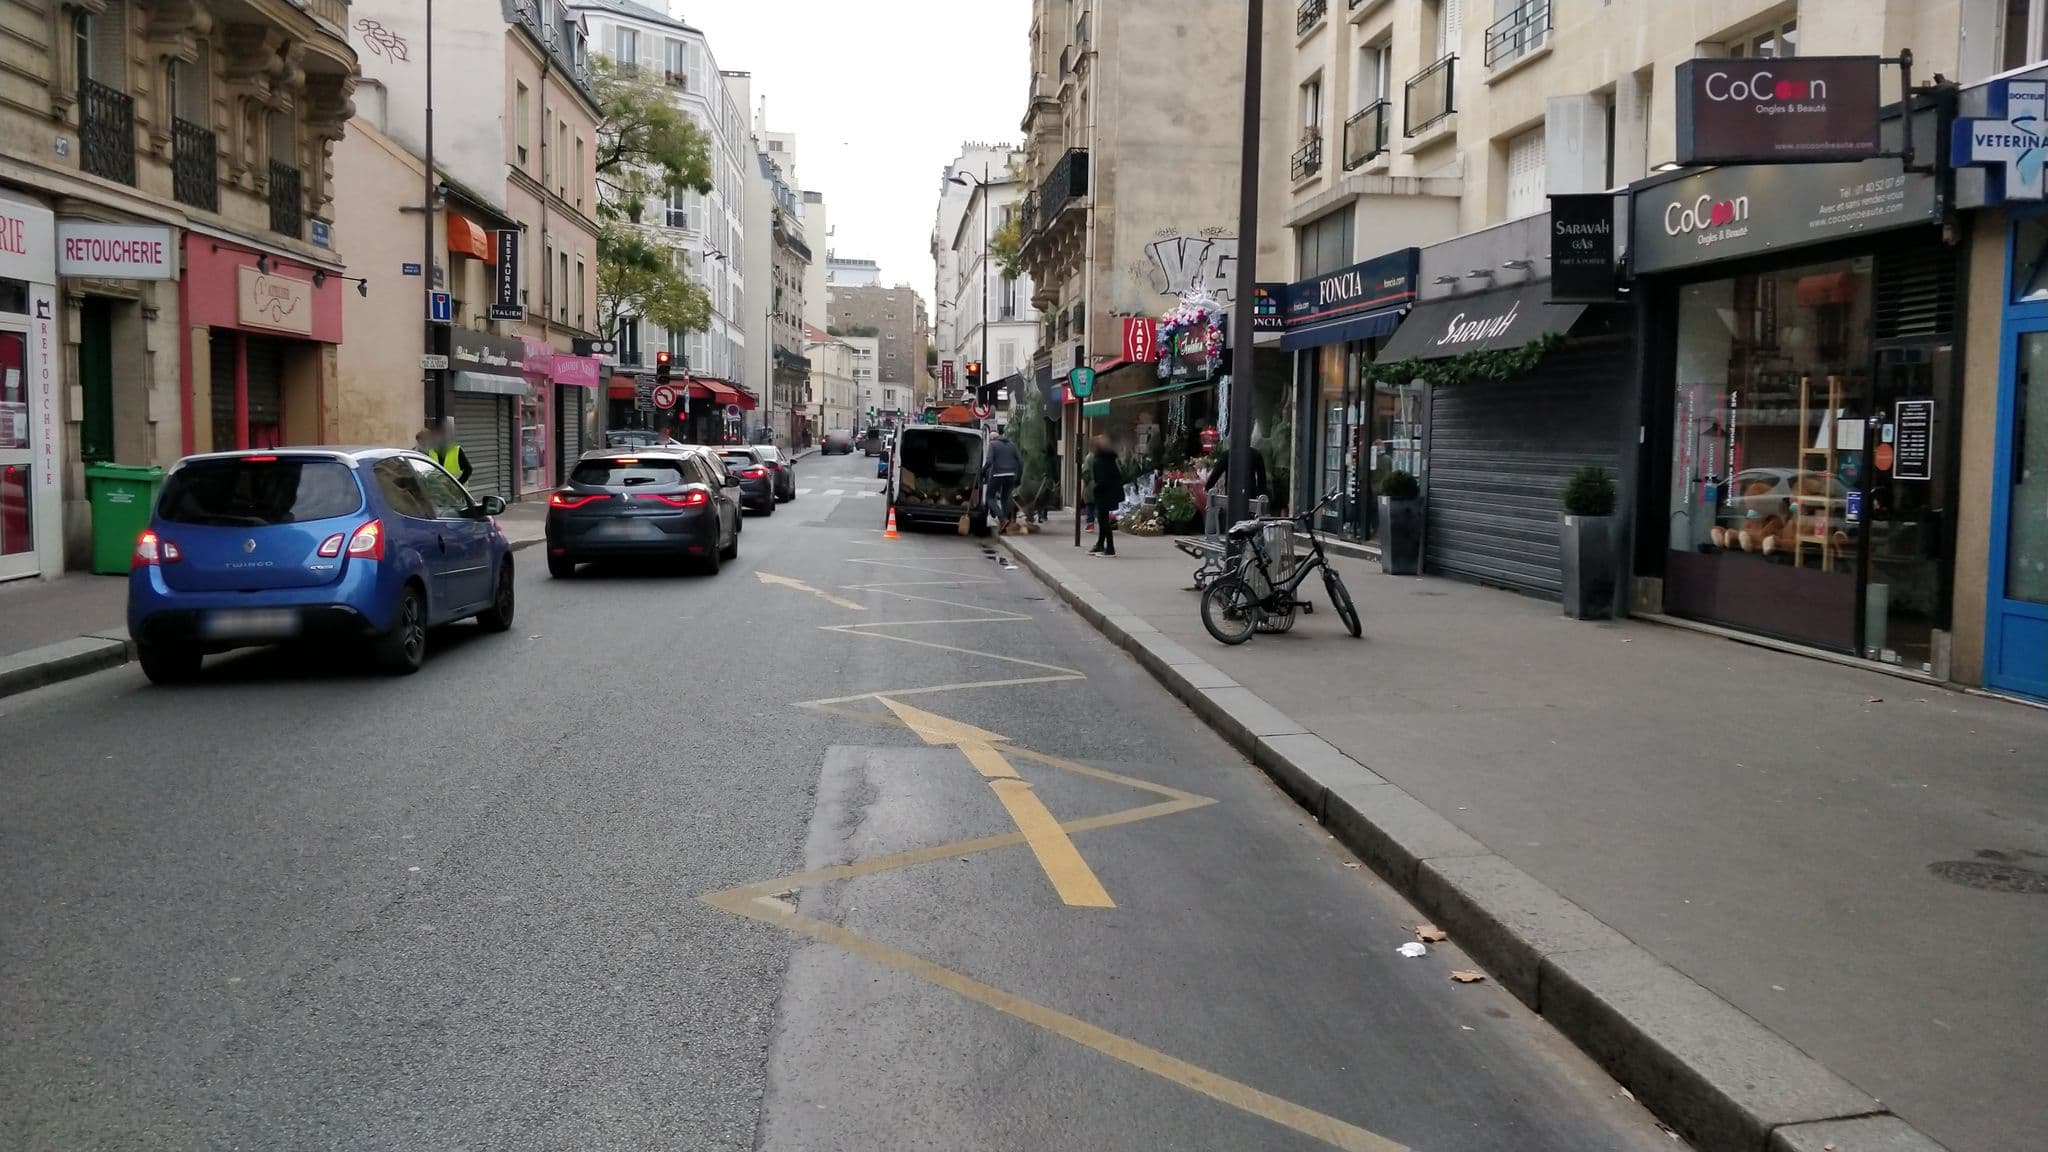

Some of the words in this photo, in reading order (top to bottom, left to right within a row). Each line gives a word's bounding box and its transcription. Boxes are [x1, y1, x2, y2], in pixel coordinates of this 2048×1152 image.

[2009, 92, 2045, 100] DOCTEUR
[1756, 104, 1786, 115] Ongles
[1788, 104, 1794, 113] &
[1797, 103, 1826, 113] Beauté
[1809, 203, 1904, 228] www.cocoonbeaute.com
[65, 238, 162, 264] RETOUCHERIE
[1697, 232, 1718, 246] Ongles
[1319, 271, 1362, 305] FONCIA
[492, 309, 521, 317] ITALIEN
[1136, 320, 1144, 361] TABAC
[41, 322, 52, 485] RETOUCHERIE
